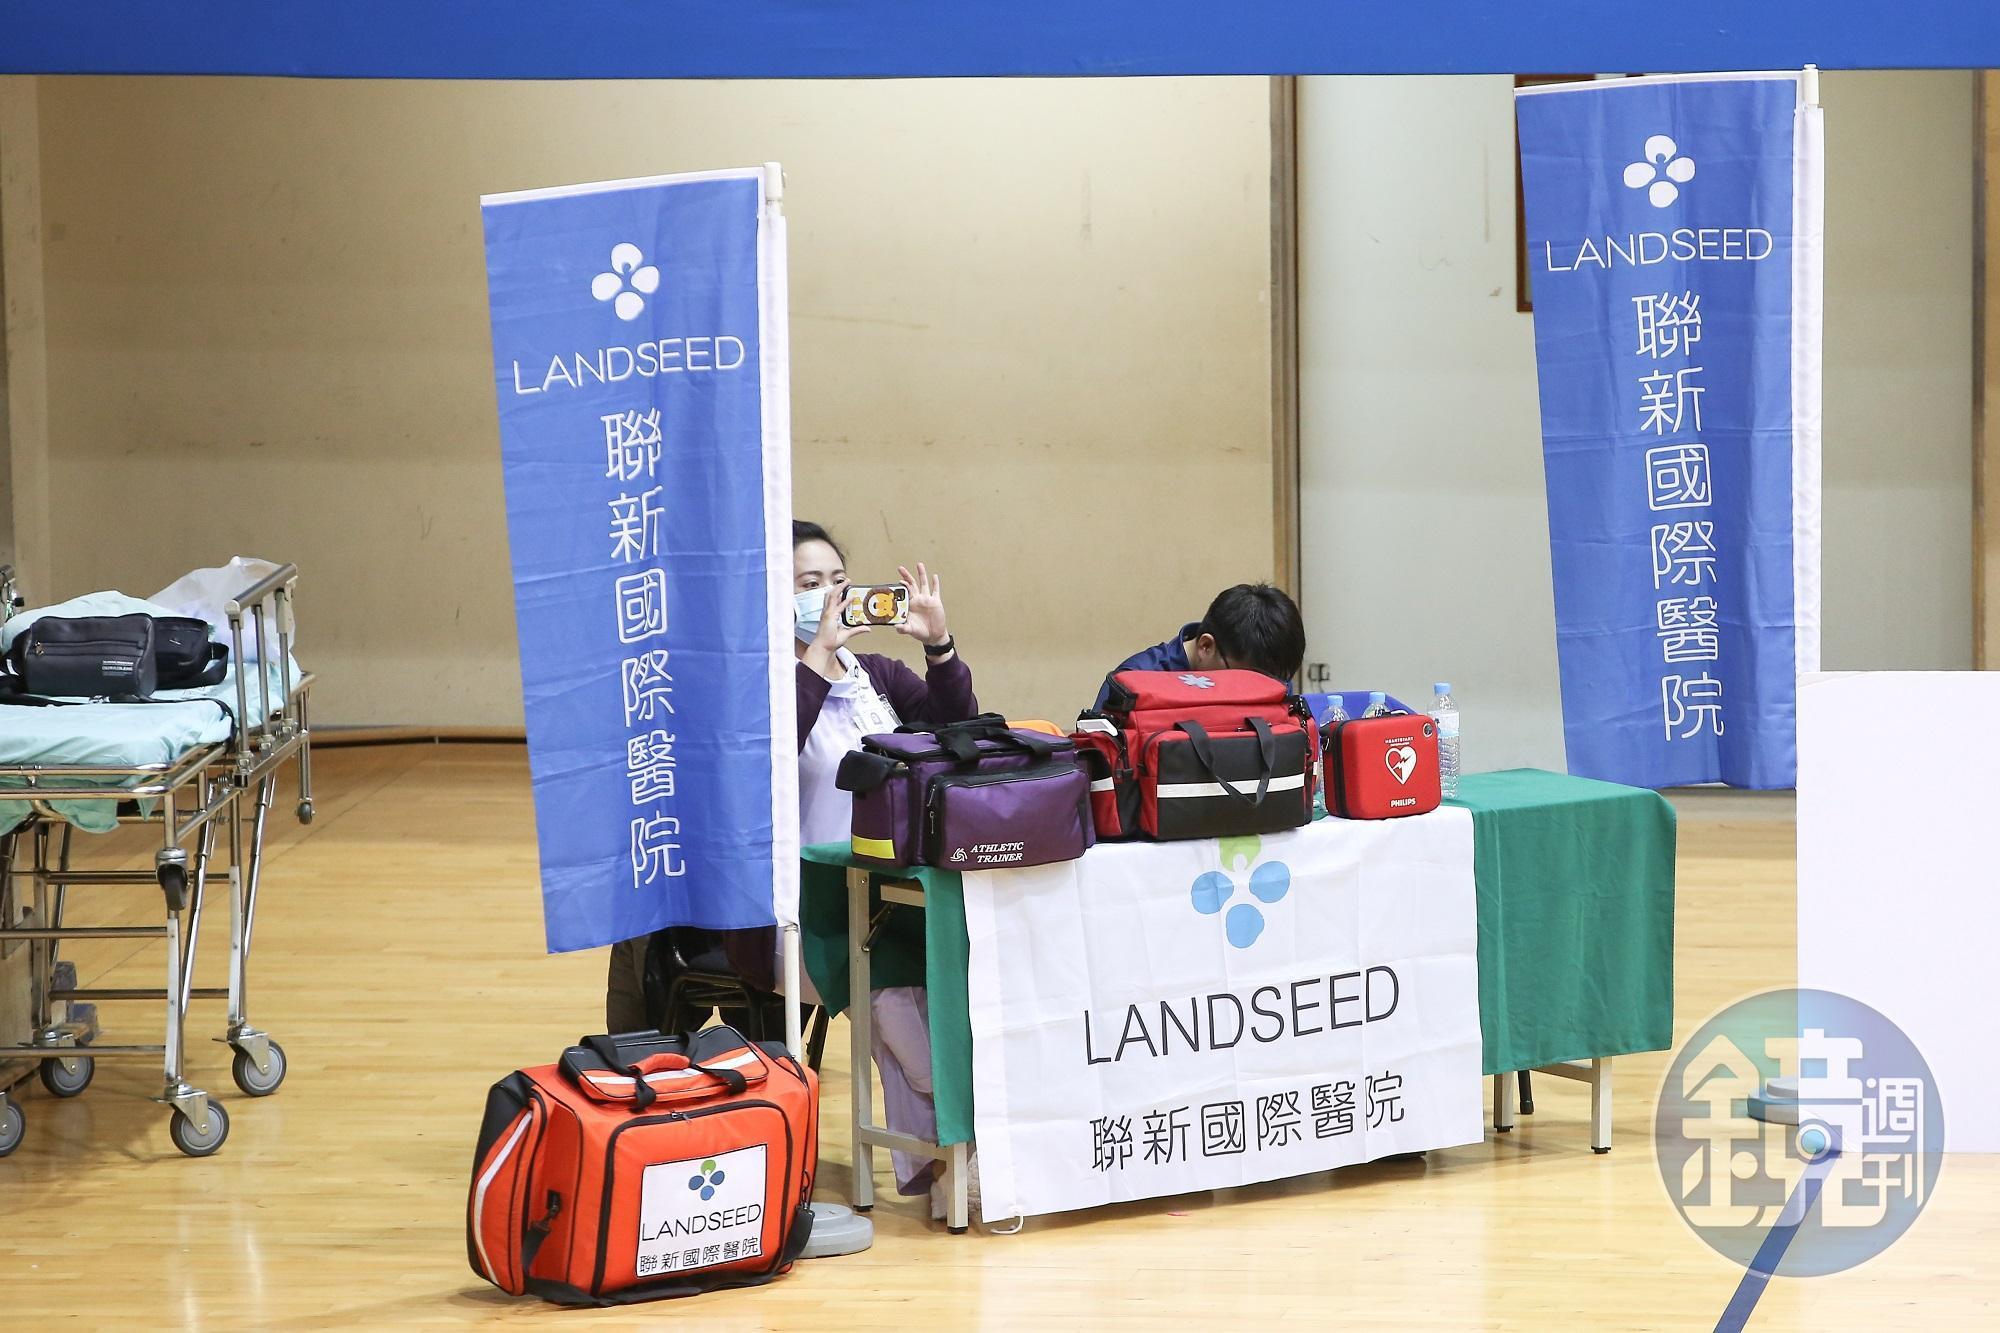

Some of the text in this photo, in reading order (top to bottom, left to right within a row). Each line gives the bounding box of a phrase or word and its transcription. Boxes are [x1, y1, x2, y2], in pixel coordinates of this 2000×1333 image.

[1546, 228, 1774, 272] LANDSEED
[513, 335, 745, 395] LANDSEED
[1632, 290, 1724, 742] 聯新國際醫院
[600, 407, 686, 889] 聯新國際醫院
[1390, 797, 1416, 807] PHILIPS
[970, 842, 1024, 853] ATHLETIC
[977, 852, 1023, 863] TRAINER
[1084, 965, 1400, 1066] LANDSEED
[1090, 1070, 1405, 1173] 聯新國際醫院
[641, 1203, 762, 1241] LANDSEED
[639, 1237, 759, 1274] 聯新國際醫院
